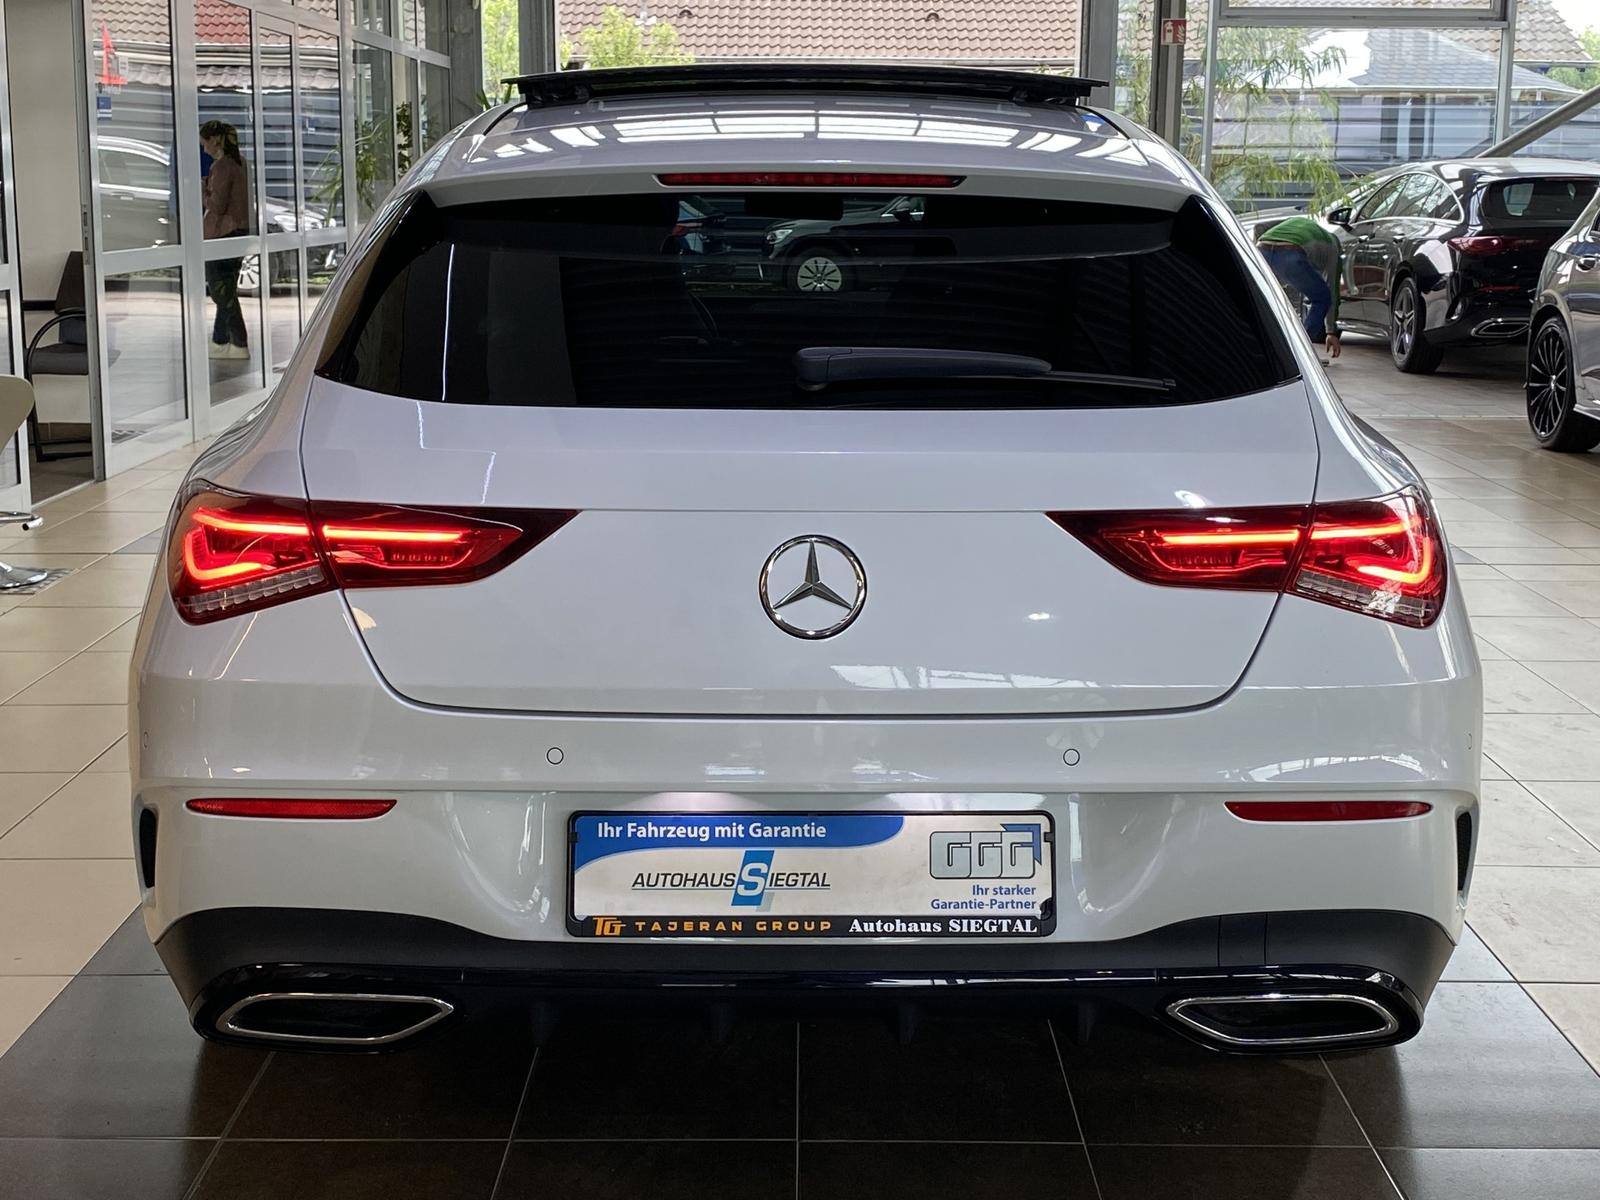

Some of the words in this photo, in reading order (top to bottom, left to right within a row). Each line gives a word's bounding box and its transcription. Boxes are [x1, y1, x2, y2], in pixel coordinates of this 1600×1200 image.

[598, 822, 622, 838] Ihr
[627, 822, 710, 841] Fahrzeug
[715, 822, 745, 838] mit
[749, 822, 827, 838] Garantie
[632, 872, 736, 888] AUTOHAUS
[972, 884, 992, 896] Ihr
[993, 884, 1036, 896] starker
[931, 898, 1036, 910] Garantie-Partner
[635, 921, 743, 931] TAJERAN
[756, 921, 831, 931] GROUP
[849, 918, 942, 933] Autohaus
[948, 918, 1038, 933] SIEGTAL
